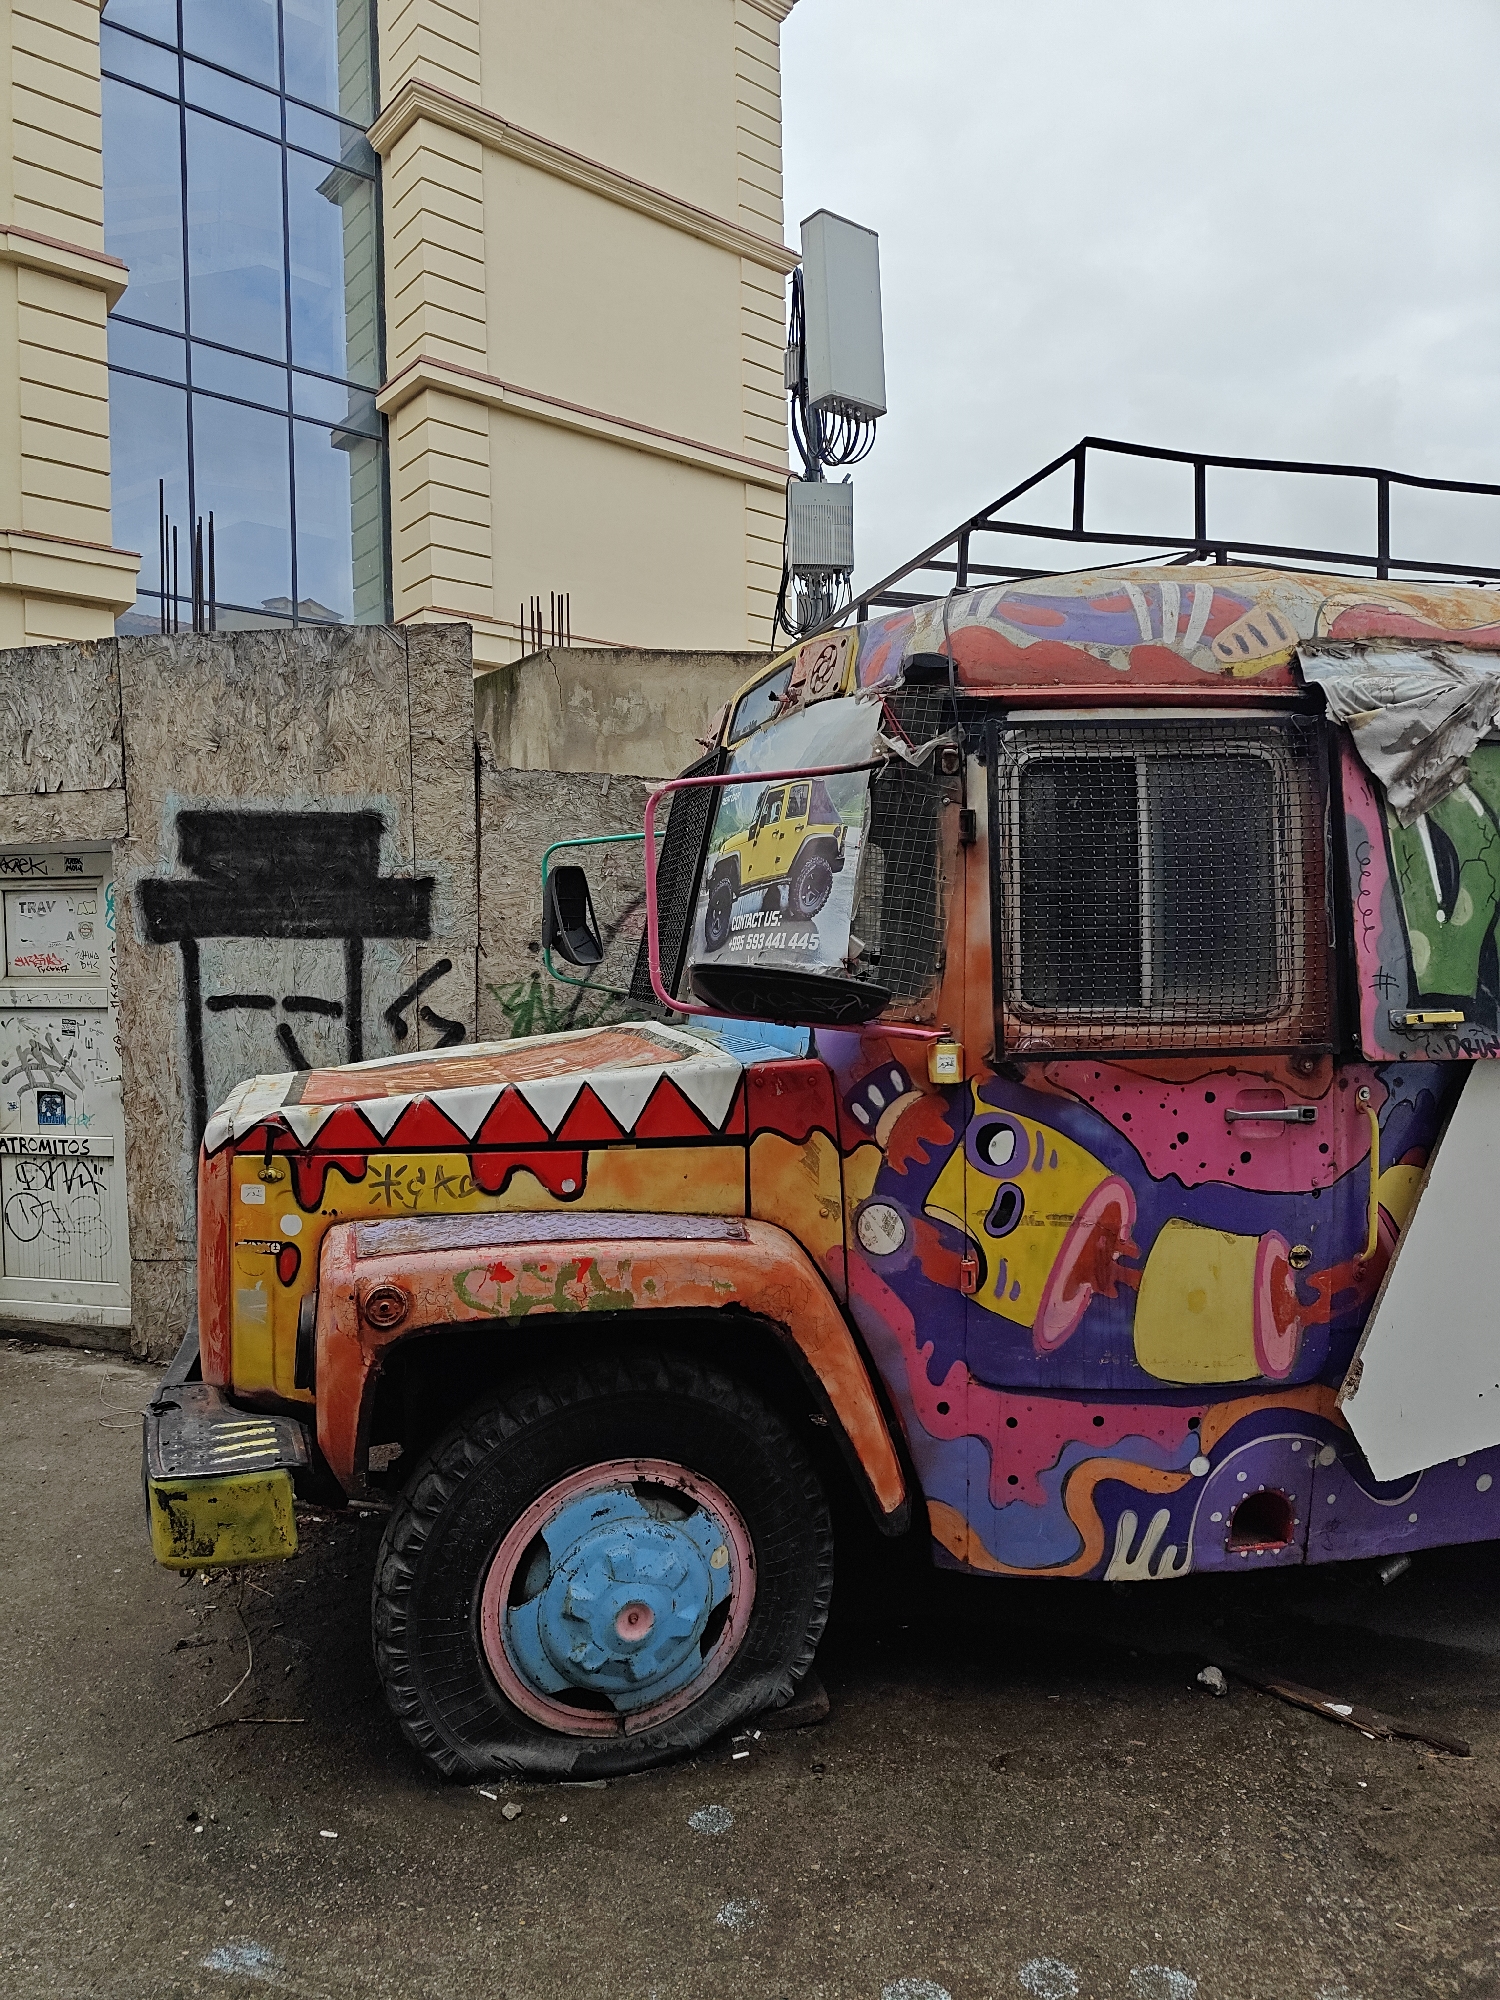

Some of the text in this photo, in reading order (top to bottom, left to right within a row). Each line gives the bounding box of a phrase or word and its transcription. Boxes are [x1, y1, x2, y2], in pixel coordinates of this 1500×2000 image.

[731, 910, 783, 932] CONTACT US:
[729, 933, 821, 952] +995 593 441 445
[0, 1137, 90, 1156] ATROMITOS
